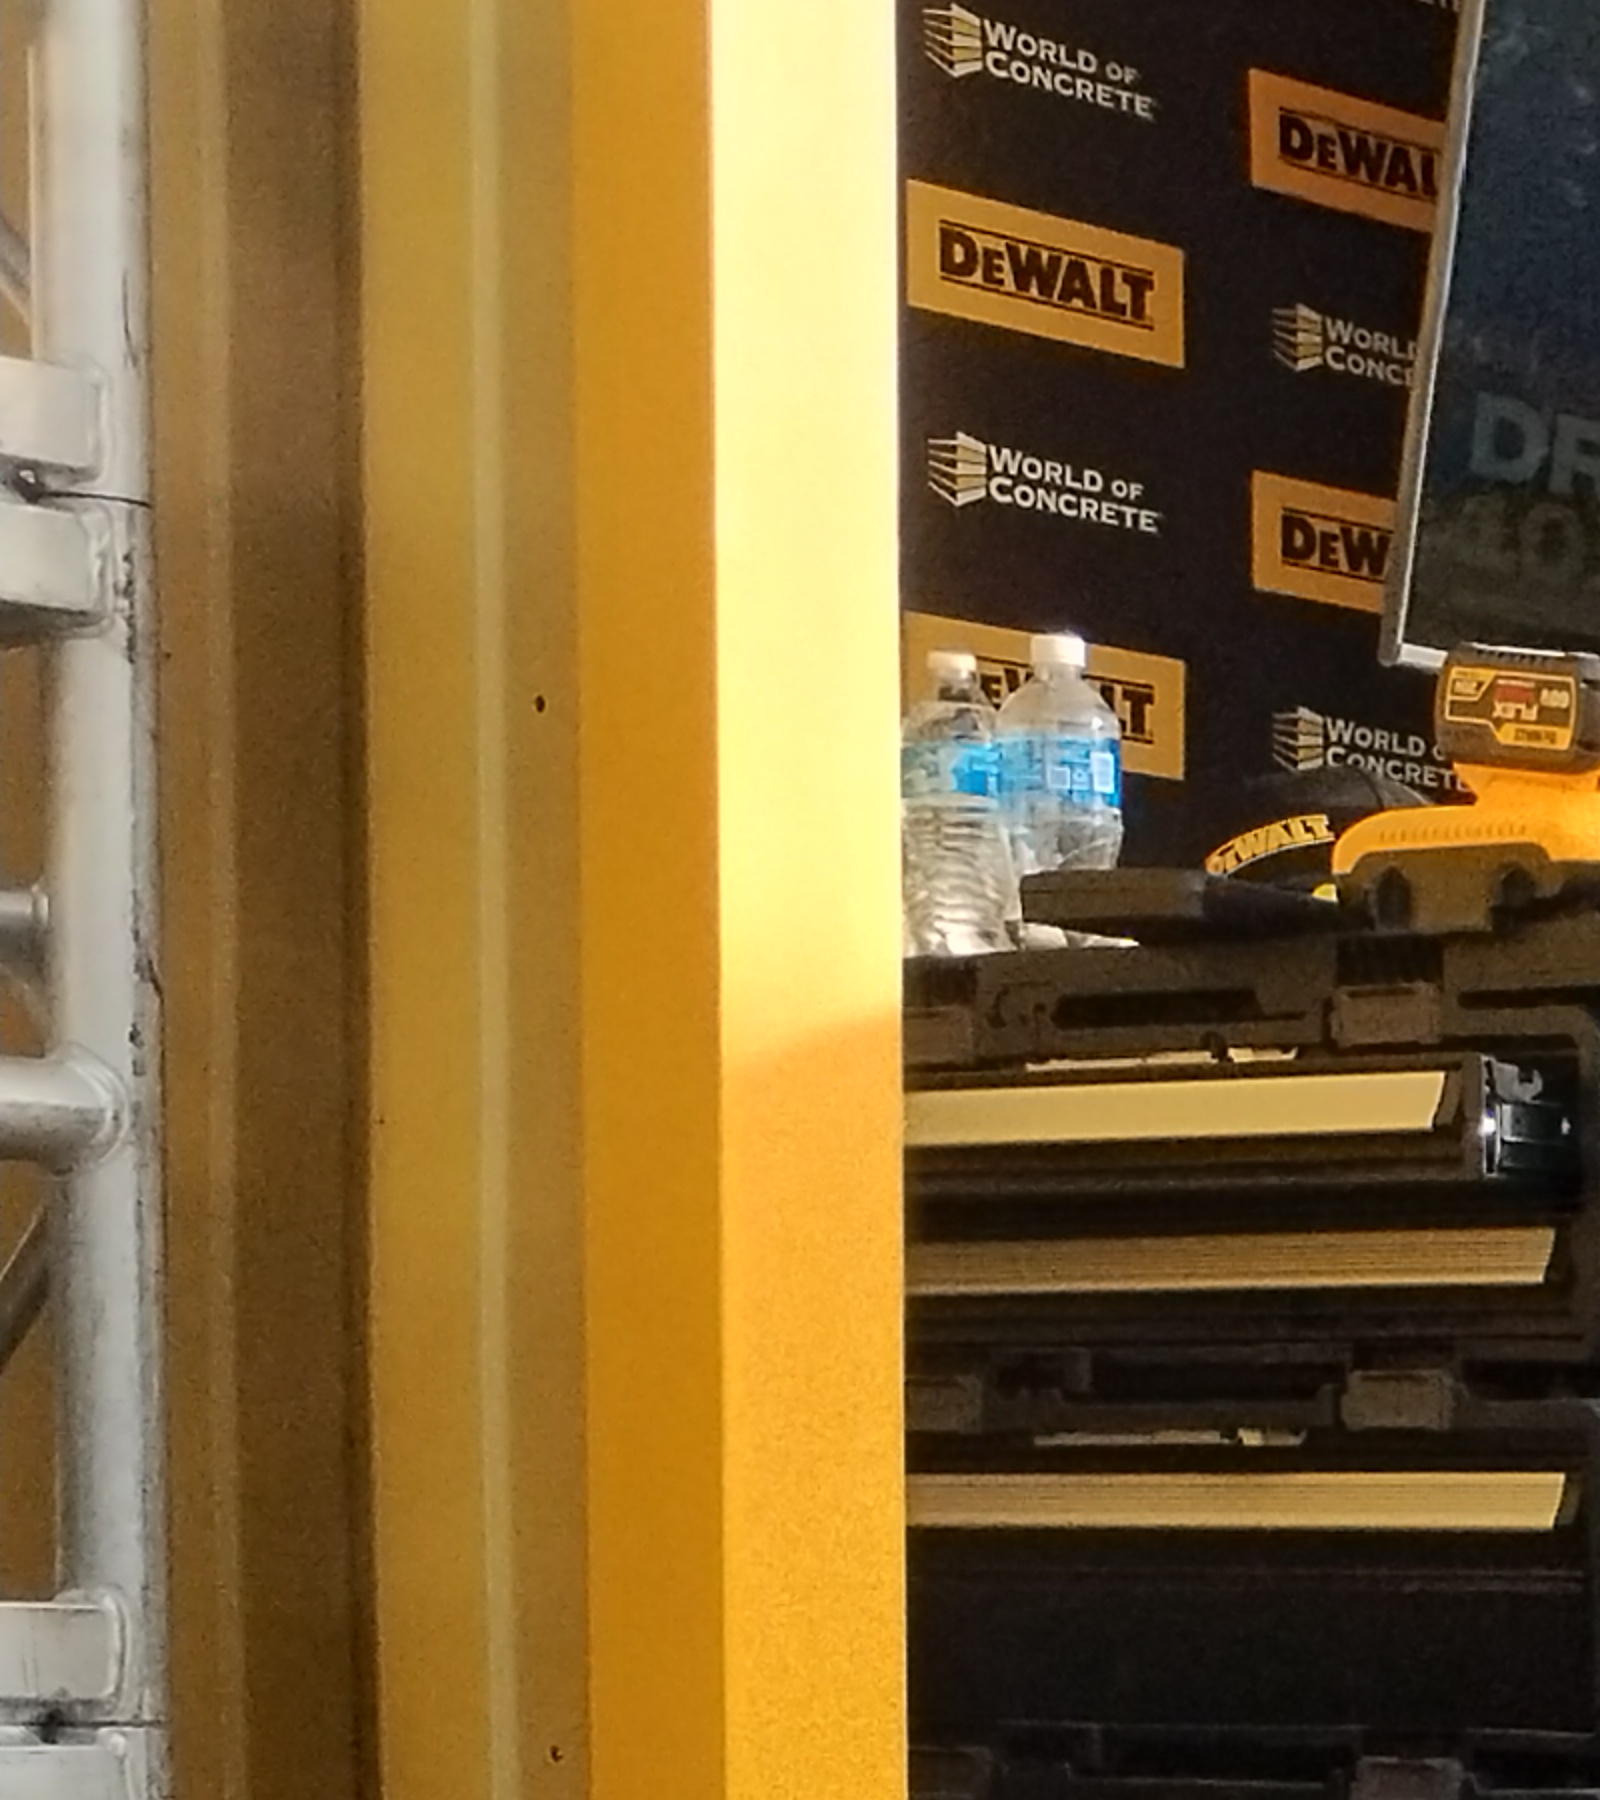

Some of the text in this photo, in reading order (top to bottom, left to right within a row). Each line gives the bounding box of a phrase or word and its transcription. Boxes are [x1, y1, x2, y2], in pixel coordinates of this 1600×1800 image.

[984, 18, 1139, 85] WORLD OF
[985, 51, 1153, 120] CONCRETE
[1280, 113, 1441, 197] DEWAL
[1325, 345, 1413, 386] CONC
[989, 444, 1144, 501] WORLD OF
[990, 476, 1159, 533] CONCRETE
[1326, 715, 1426, 757] WORLD
